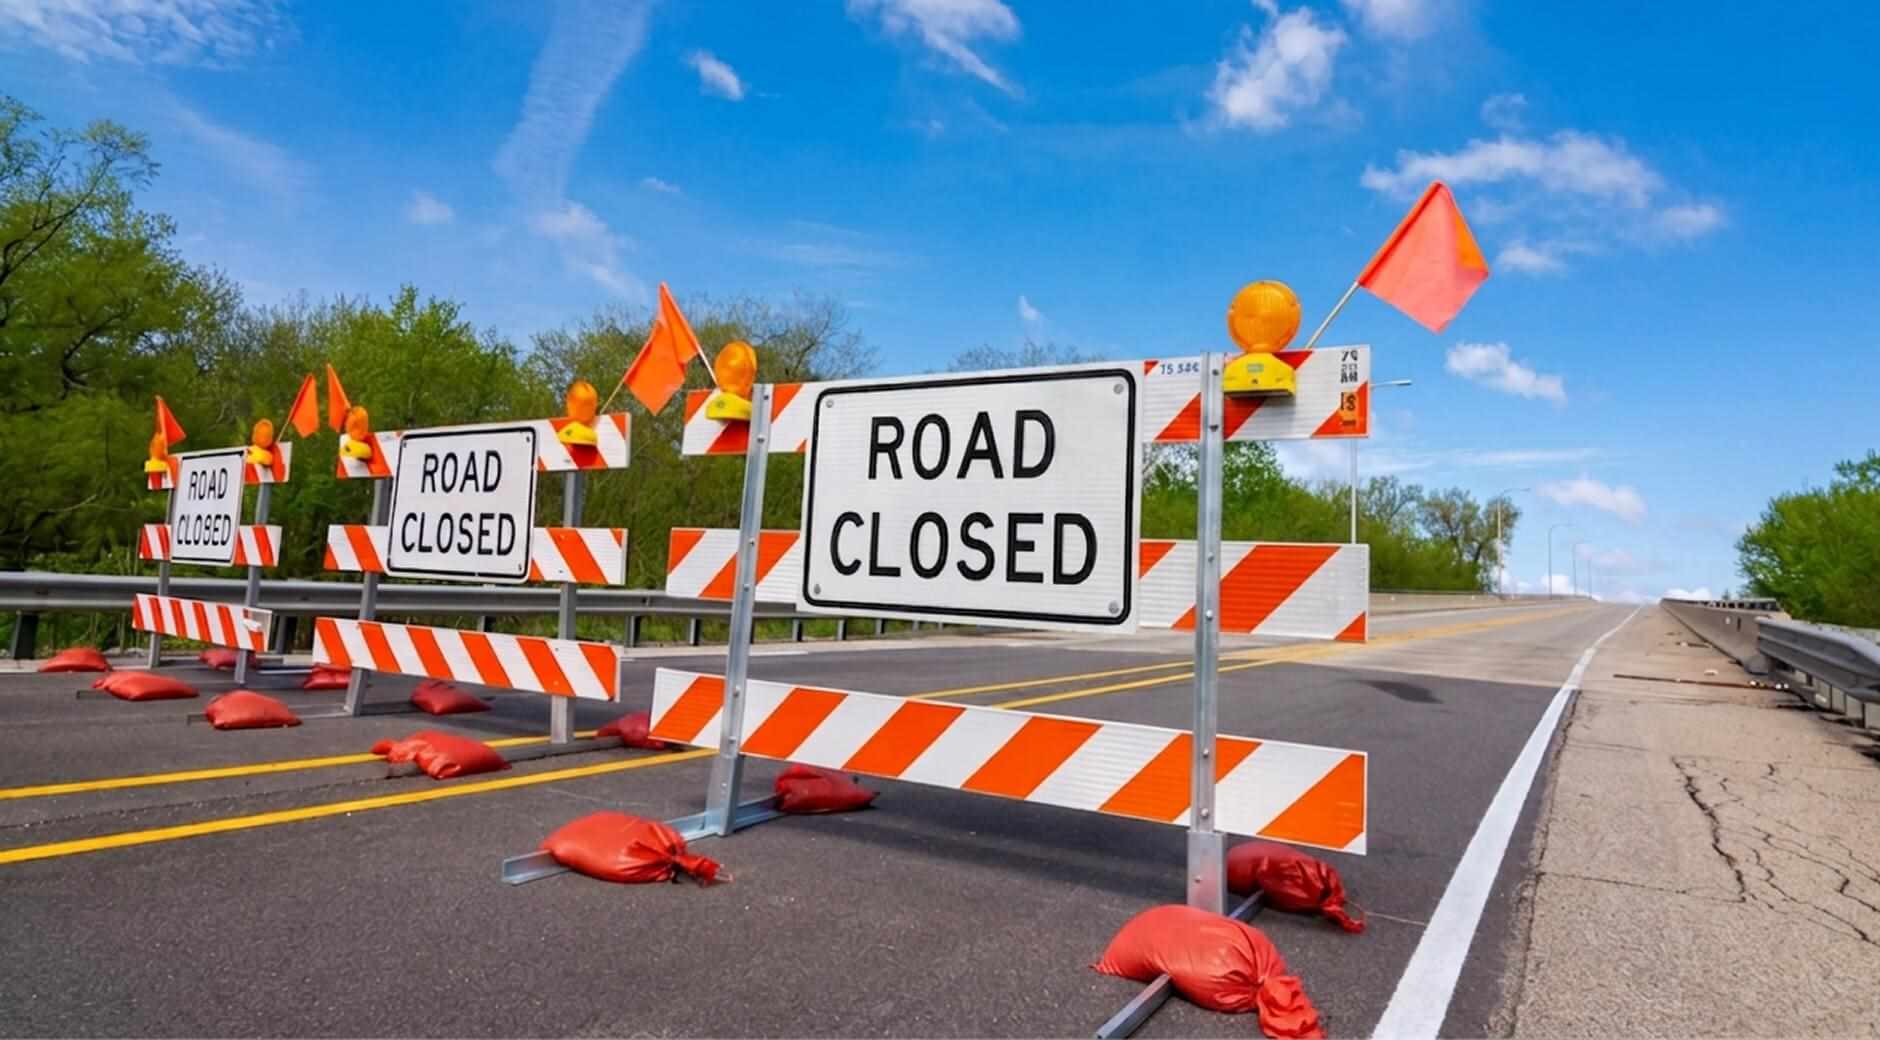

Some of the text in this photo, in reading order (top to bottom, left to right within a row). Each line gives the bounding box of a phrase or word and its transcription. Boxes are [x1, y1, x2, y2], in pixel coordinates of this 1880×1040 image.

[868, 409, 1056, 481] ROAD
[188, 467, 228, 501] ROAD
[420, 450, 502, 494] ROAD
[176, 514, 232, 547] CLOSED
[401, 511, 516, 557] CLOSED
[829, 511, 1098, 586] CLOSED
